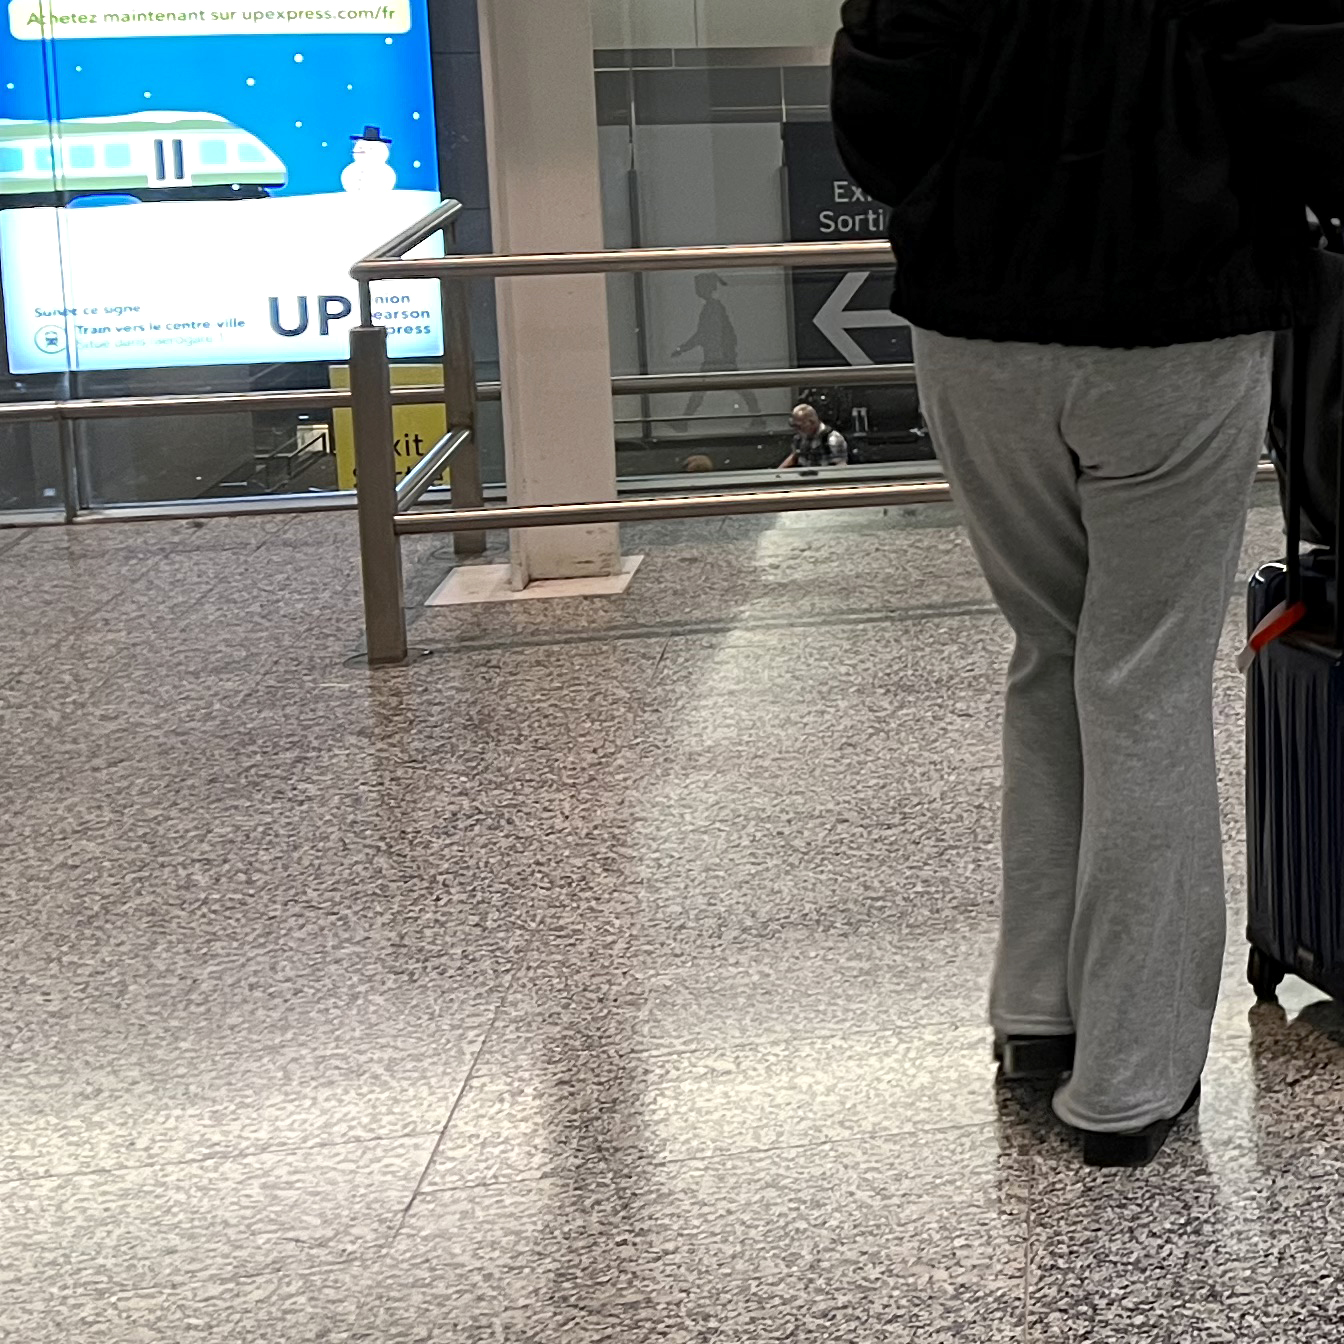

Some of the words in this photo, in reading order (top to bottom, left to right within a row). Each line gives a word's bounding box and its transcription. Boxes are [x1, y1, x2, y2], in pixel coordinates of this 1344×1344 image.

[103, 9, 205, 24] maintenant
[210, 9, 237, 22] sur
[241, 5, 396, 24] upexpress.com/fr
[819, 209, 885, 233] Sorti
[374, 293, 411, 305] nion
[268, 294, 352, 337] UP
[371, 308, 431, 321] earson
[393, 433, 424, 456] xit
